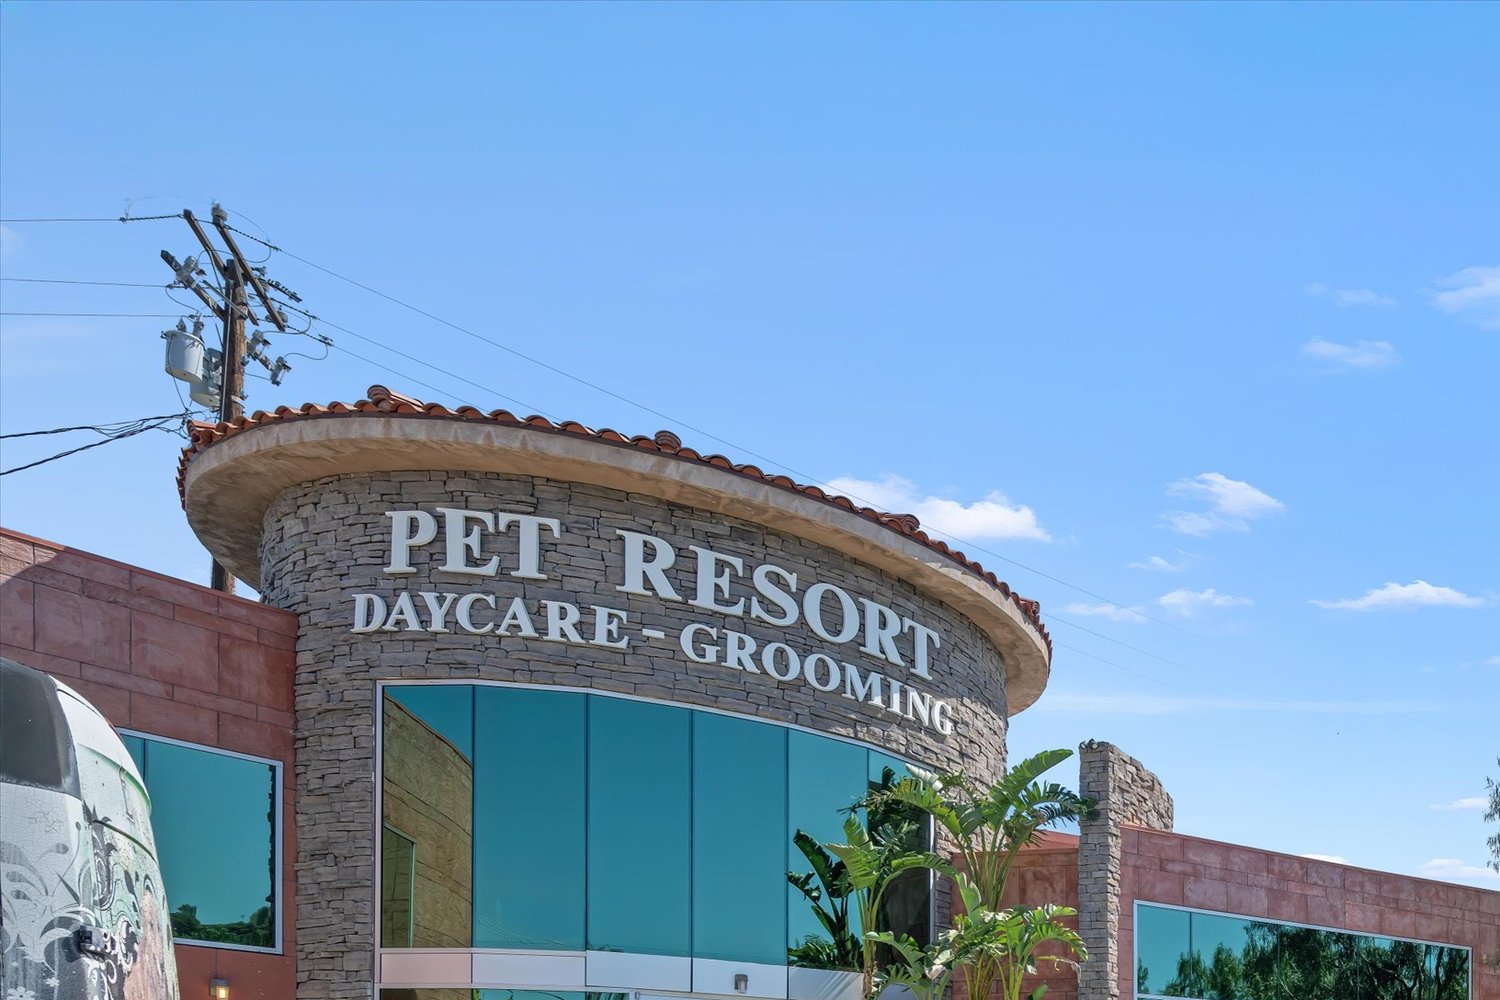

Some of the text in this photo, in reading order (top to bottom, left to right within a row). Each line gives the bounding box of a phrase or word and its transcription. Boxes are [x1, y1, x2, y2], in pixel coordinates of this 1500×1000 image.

[350, 591, 630, 650] DAYCARE
[679, 622, 955, 736] GROOMING
[383, 507, 940, 681] PET RESORT
